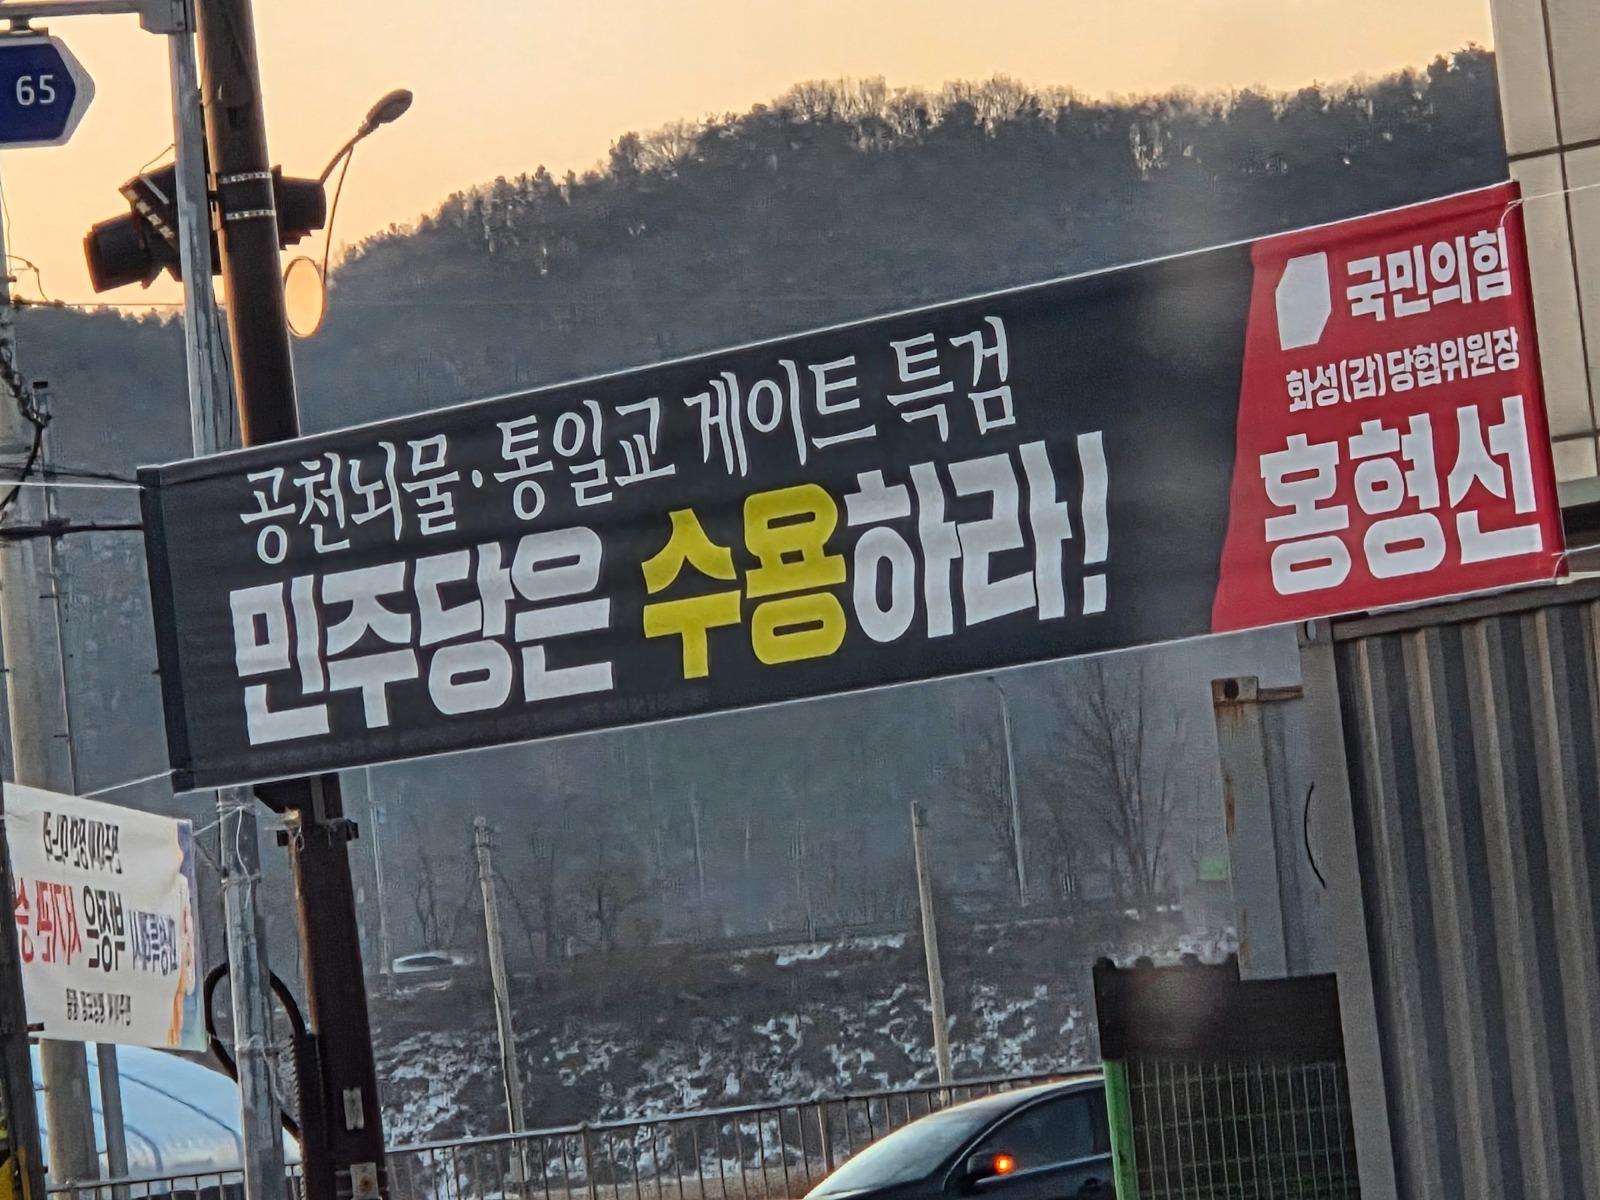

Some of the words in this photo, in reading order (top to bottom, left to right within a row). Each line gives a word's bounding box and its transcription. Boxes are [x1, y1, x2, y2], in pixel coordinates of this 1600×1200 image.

[16, 74, 56, 106] 65
[1346, 227, 1512, 322] 국민의힘
[683, 358, 877, 477] 게이트
[886, 315, 1016, 443] 특검
[1259, 394, 1543, 596] 홍형선
[229, 526, 614, 746] 민주당은
